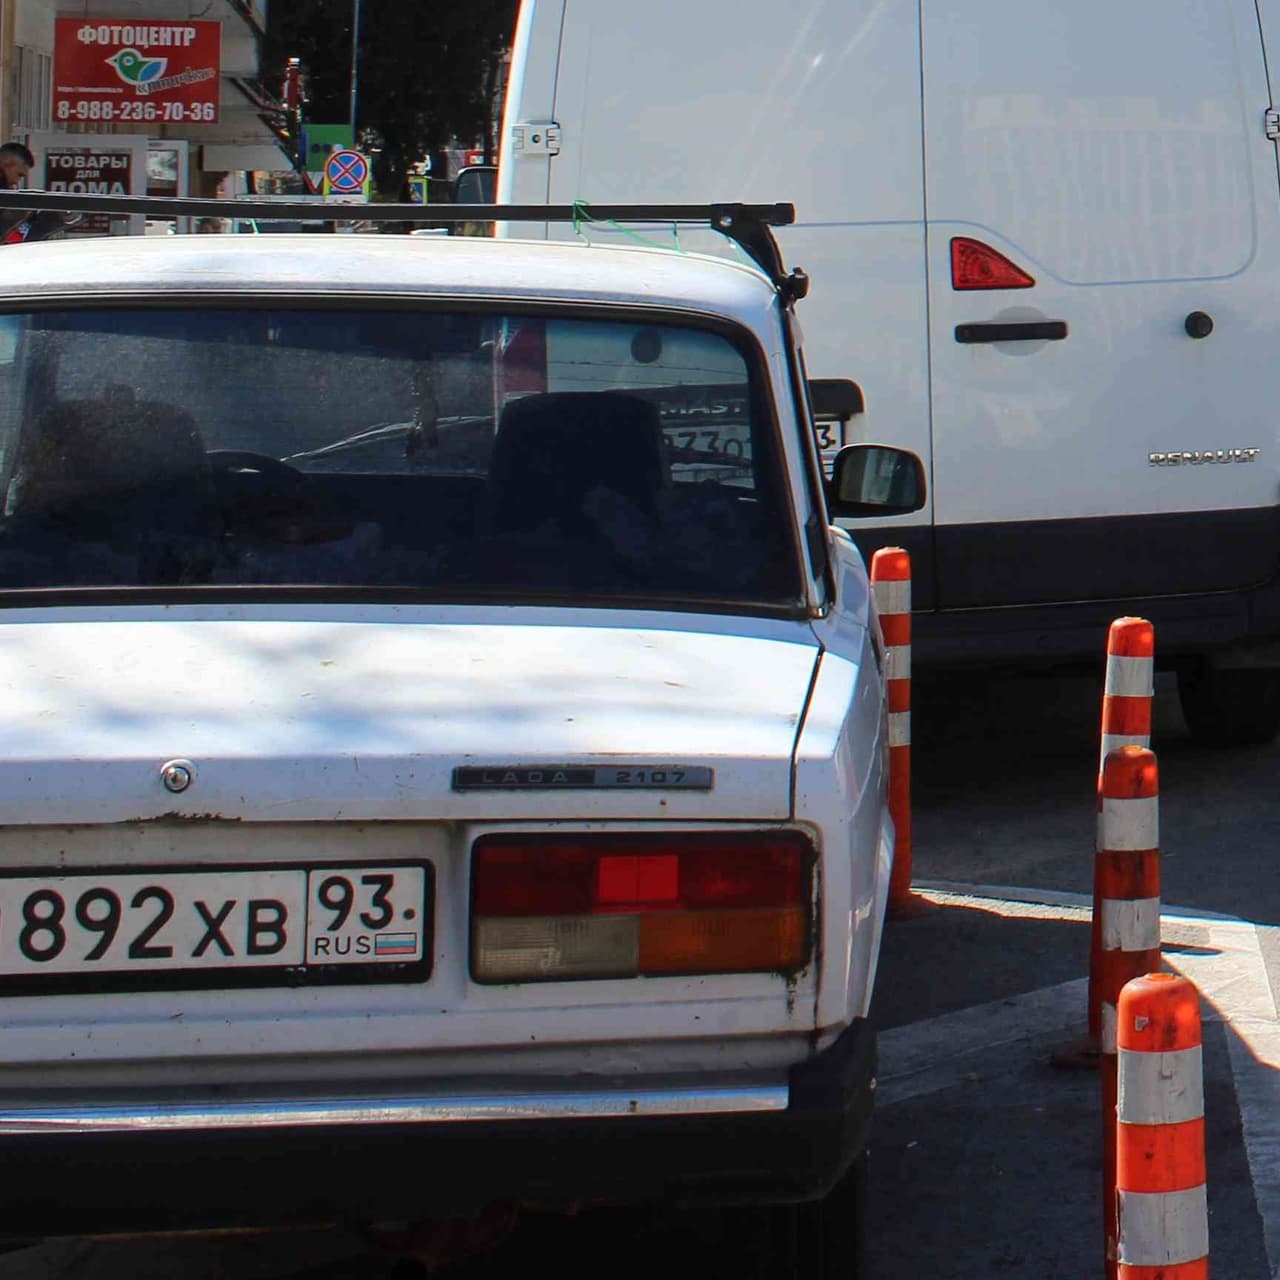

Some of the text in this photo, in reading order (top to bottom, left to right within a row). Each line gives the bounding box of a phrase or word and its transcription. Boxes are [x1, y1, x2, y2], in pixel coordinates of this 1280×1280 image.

[76, 24, 197, 48] ФОТОЦЕНТР
[57, 100, 216, 121] 8-988-236-70-36
[48, 155, 129, 169] ТОВАРЫ
[1148, 448, 1261, 466] RENAULT
[482, 770, 687, 784] LADA 2107
[317, 873, 395, 932] 93
[314, 935, 371, 956] RUS
